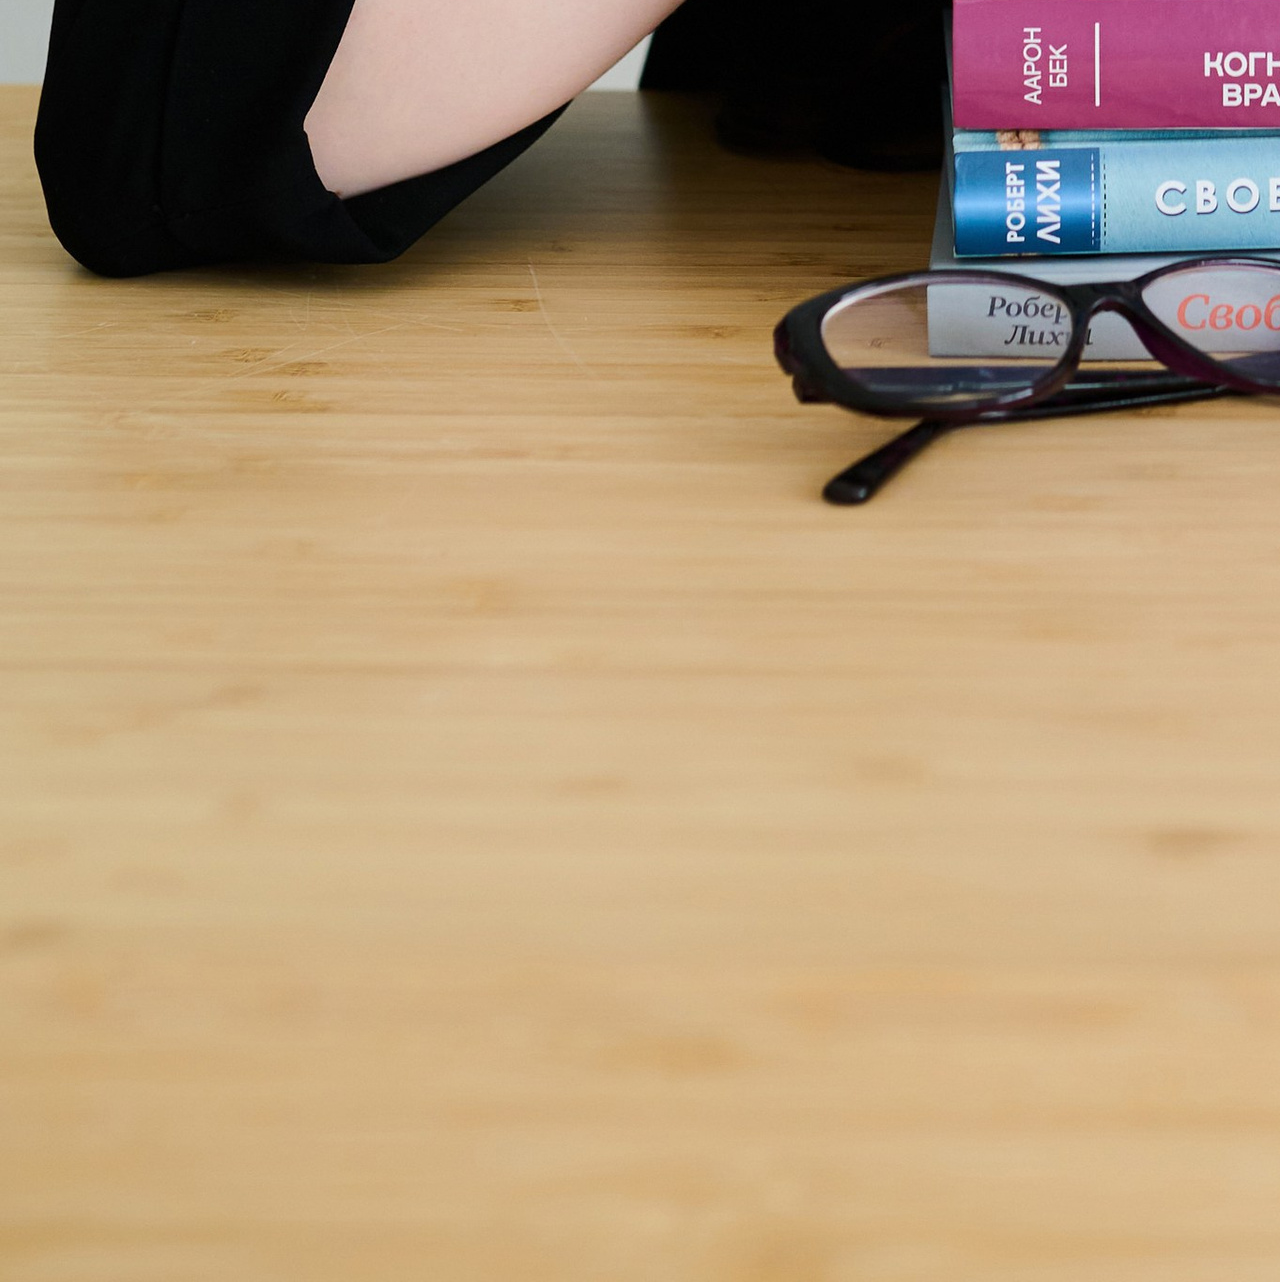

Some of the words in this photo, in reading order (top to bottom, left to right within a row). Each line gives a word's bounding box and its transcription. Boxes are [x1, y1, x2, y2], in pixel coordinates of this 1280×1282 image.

[1022, 27, 1042, 105] ААРОН
[1048, 44, 1068, 87] БЕК
[1005, 160, 1026, 243] РОБЕРТ
[1036, 159, 1062, 244] ЛИХИ
